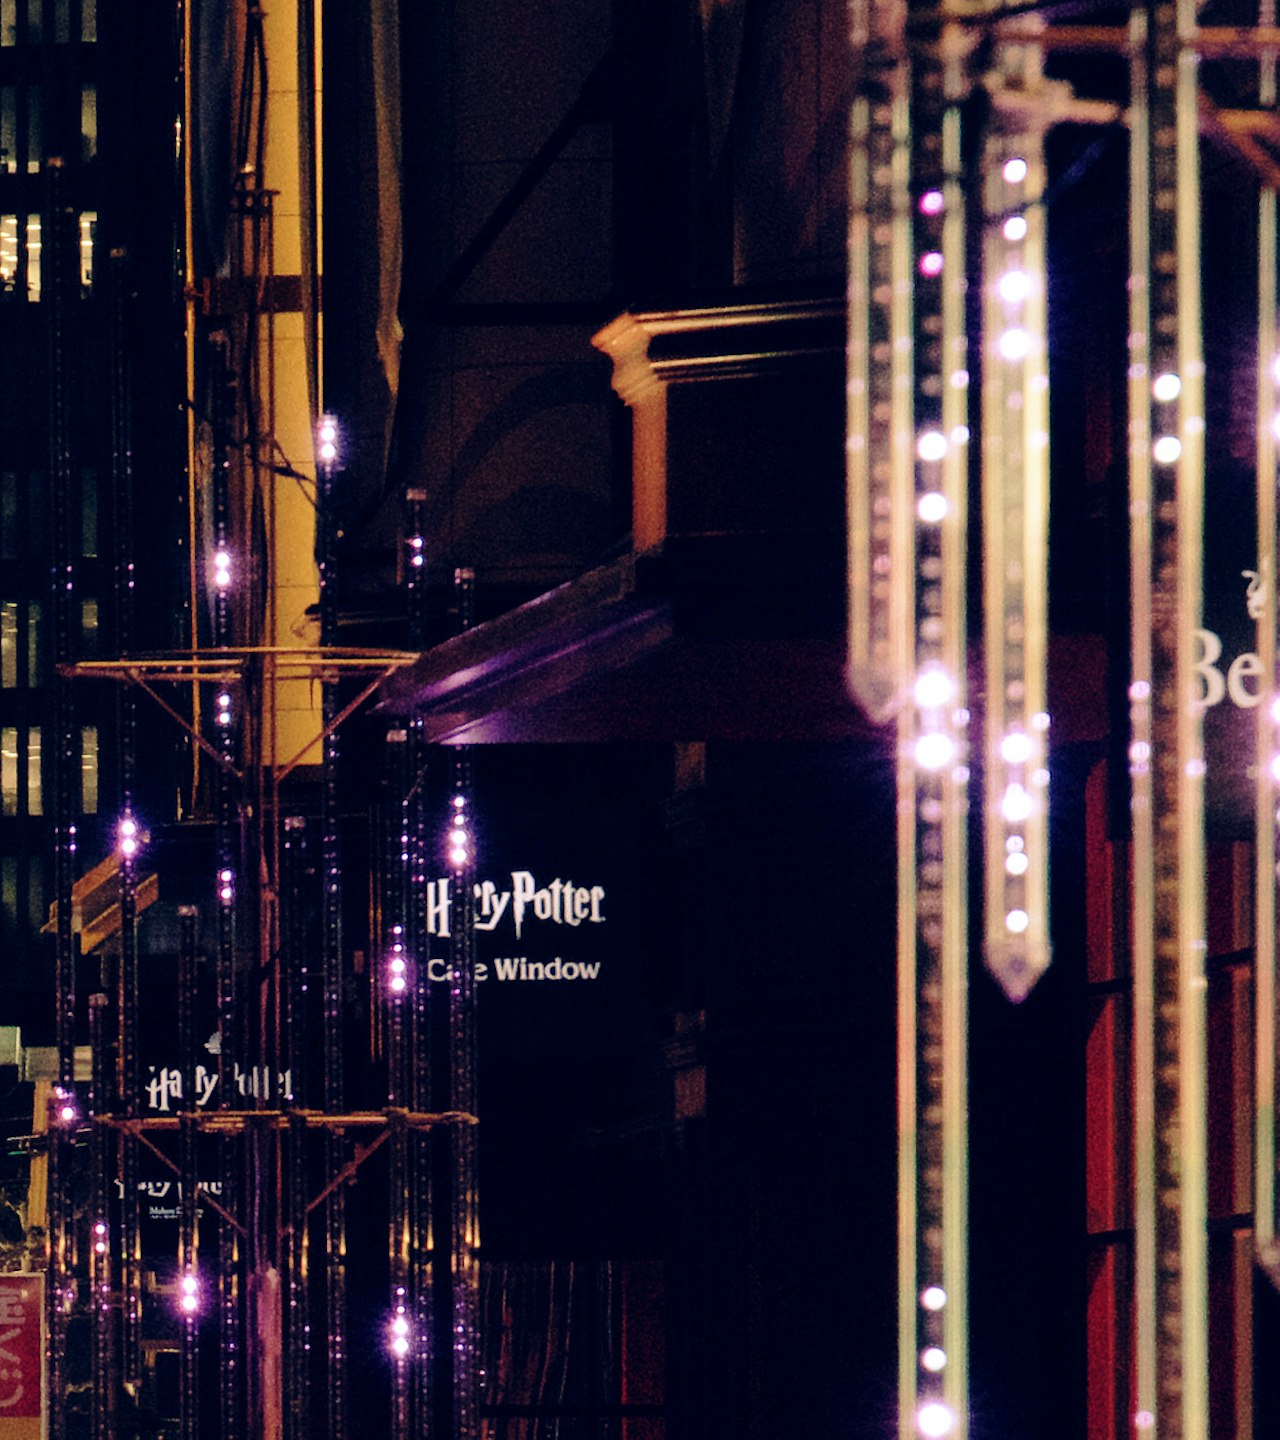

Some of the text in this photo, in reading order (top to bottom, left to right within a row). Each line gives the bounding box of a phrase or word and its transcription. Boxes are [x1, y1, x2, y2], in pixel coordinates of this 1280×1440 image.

[426, 870, 606, 941] Hry Potter
[427, 957, 601, 982] Ce Window
[145, 1065, 219, 1111] Hary
